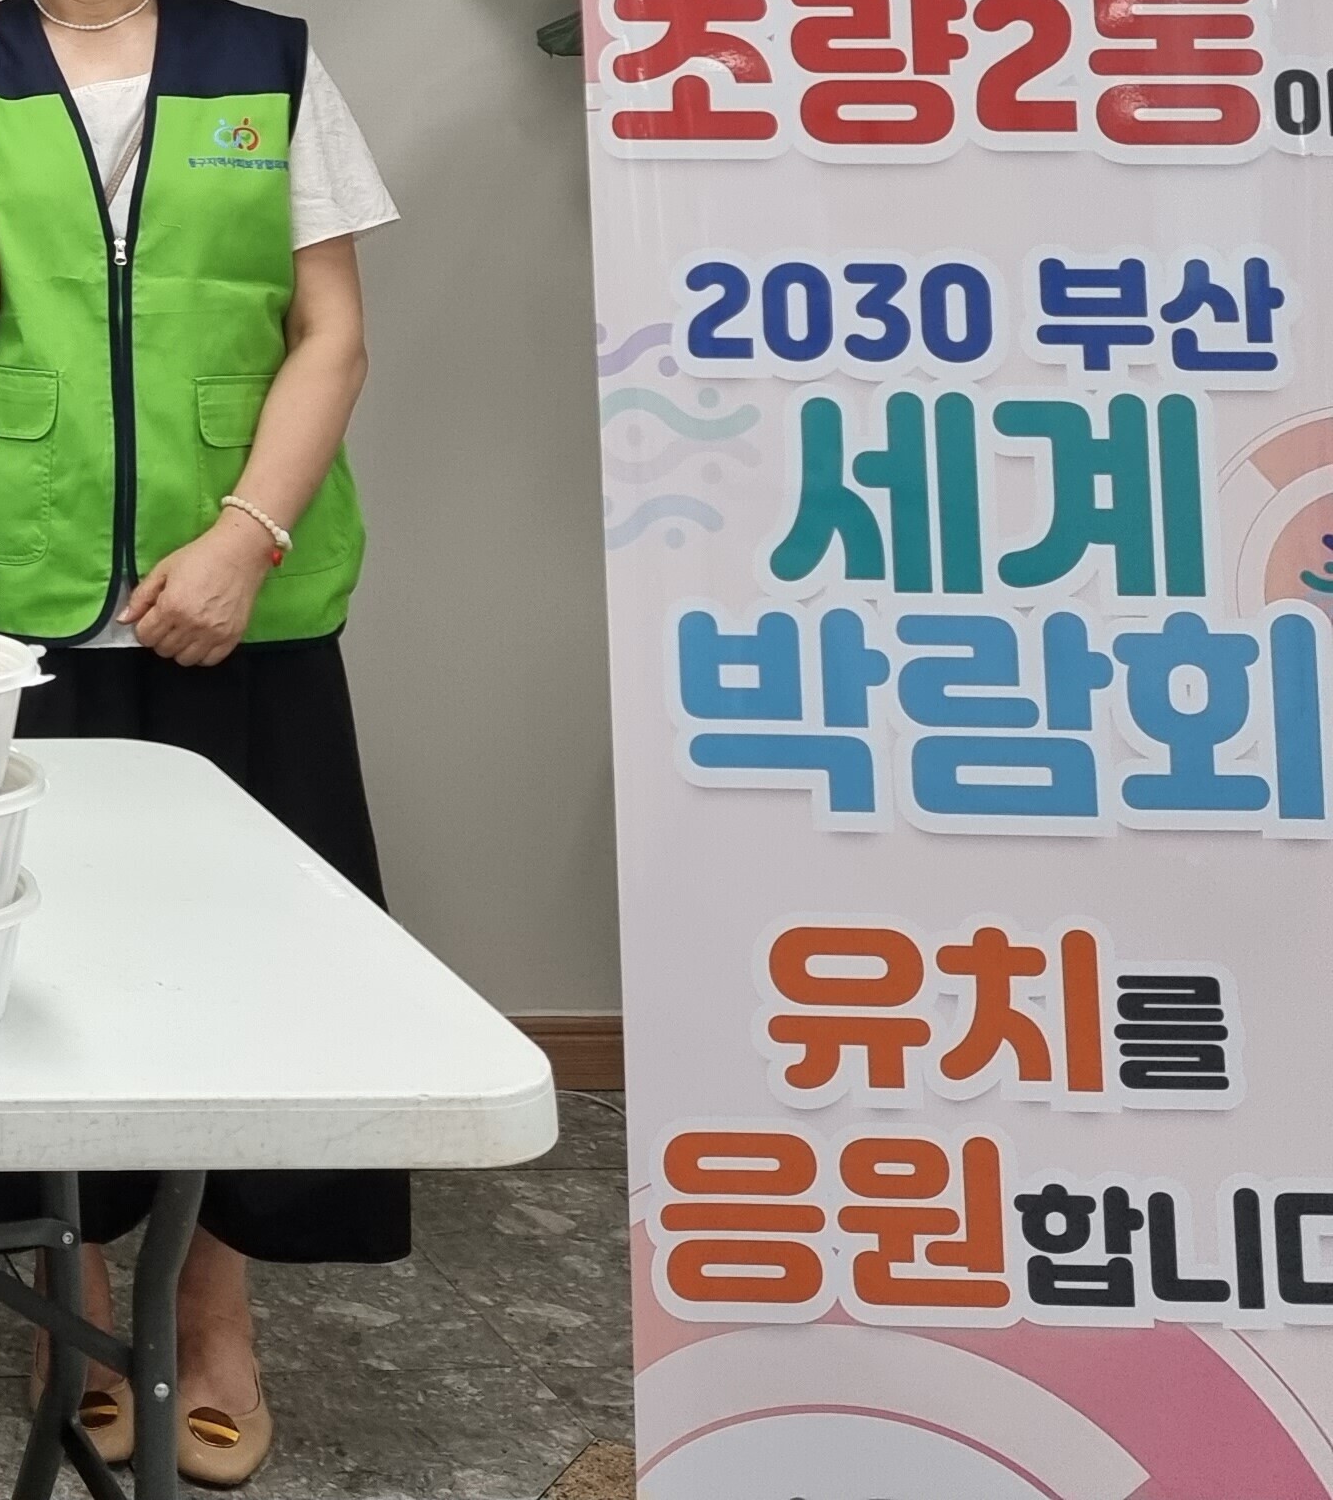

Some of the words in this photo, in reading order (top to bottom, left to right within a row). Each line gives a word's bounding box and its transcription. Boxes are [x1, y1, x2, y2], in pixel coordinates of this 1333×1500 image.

[685, 261, 994, 364] 2030
[1036, 257, 1286, 371] 부산
[769, 391, 1207, 598] 세계
[678, 608, 1326, 821] 박람회
[767, 926, 1230, 1093] 유치를
